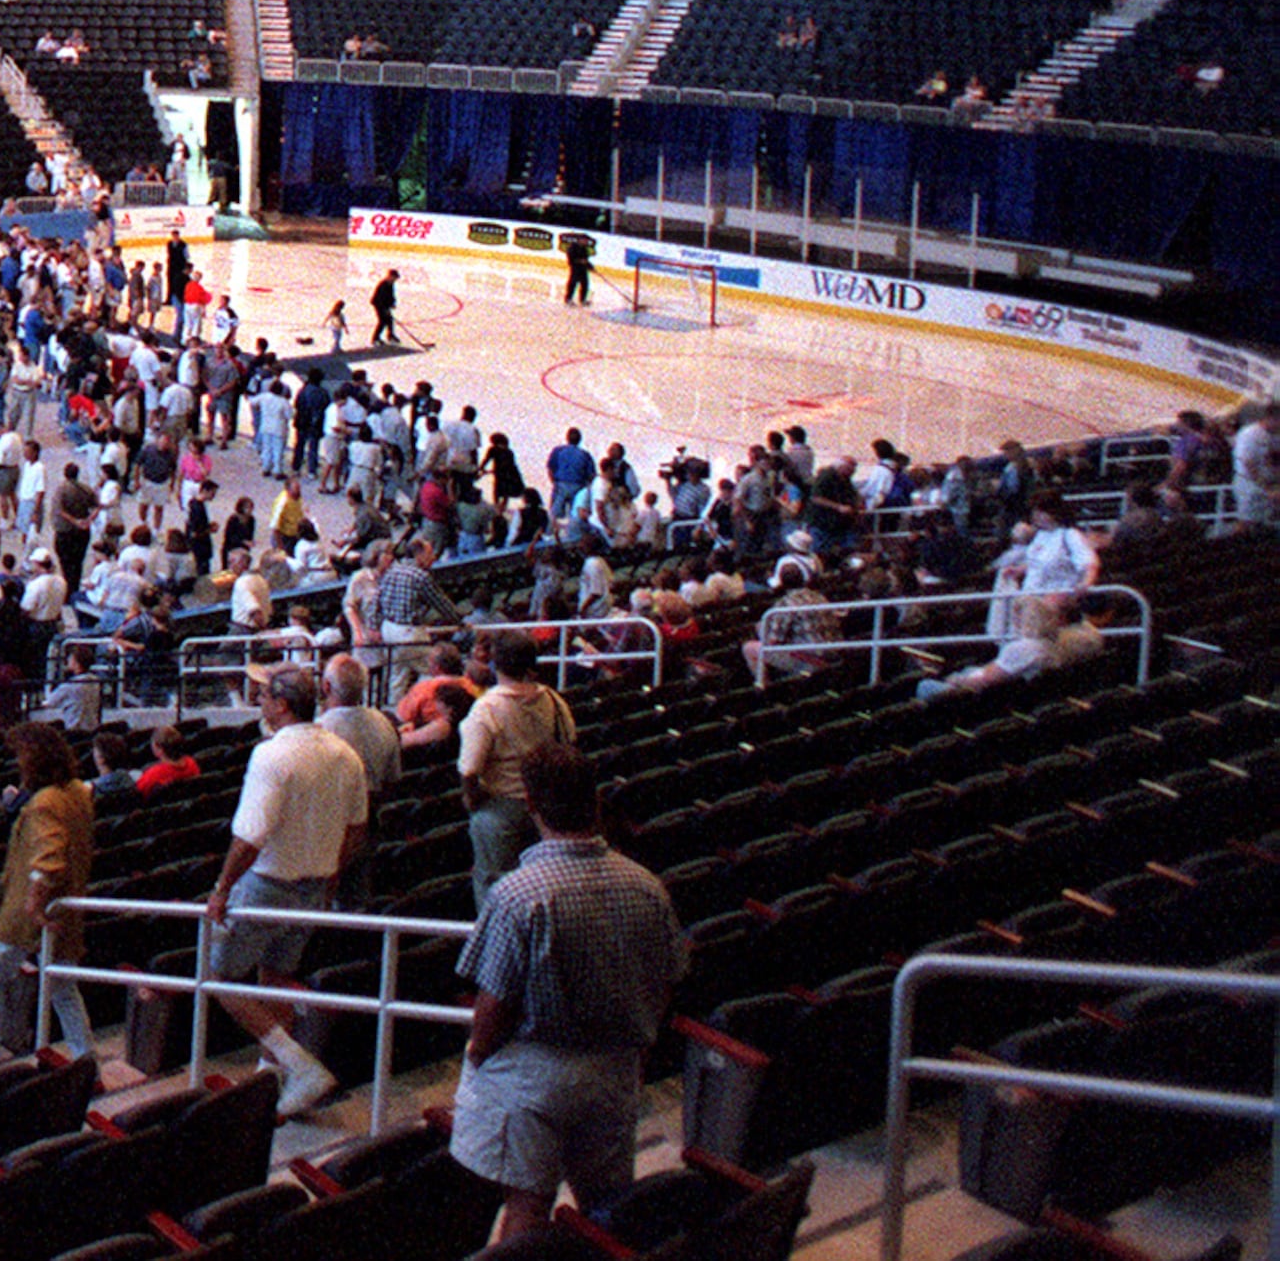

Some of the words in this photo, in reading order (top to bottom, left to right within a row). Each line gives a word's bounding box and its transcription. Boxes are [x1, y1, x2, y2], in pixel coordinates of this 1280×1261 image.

[370, 213, 434, 234] Office
[371, 225, 429, 239] DEPOT
[810, 270, 927, 312] WebMD
